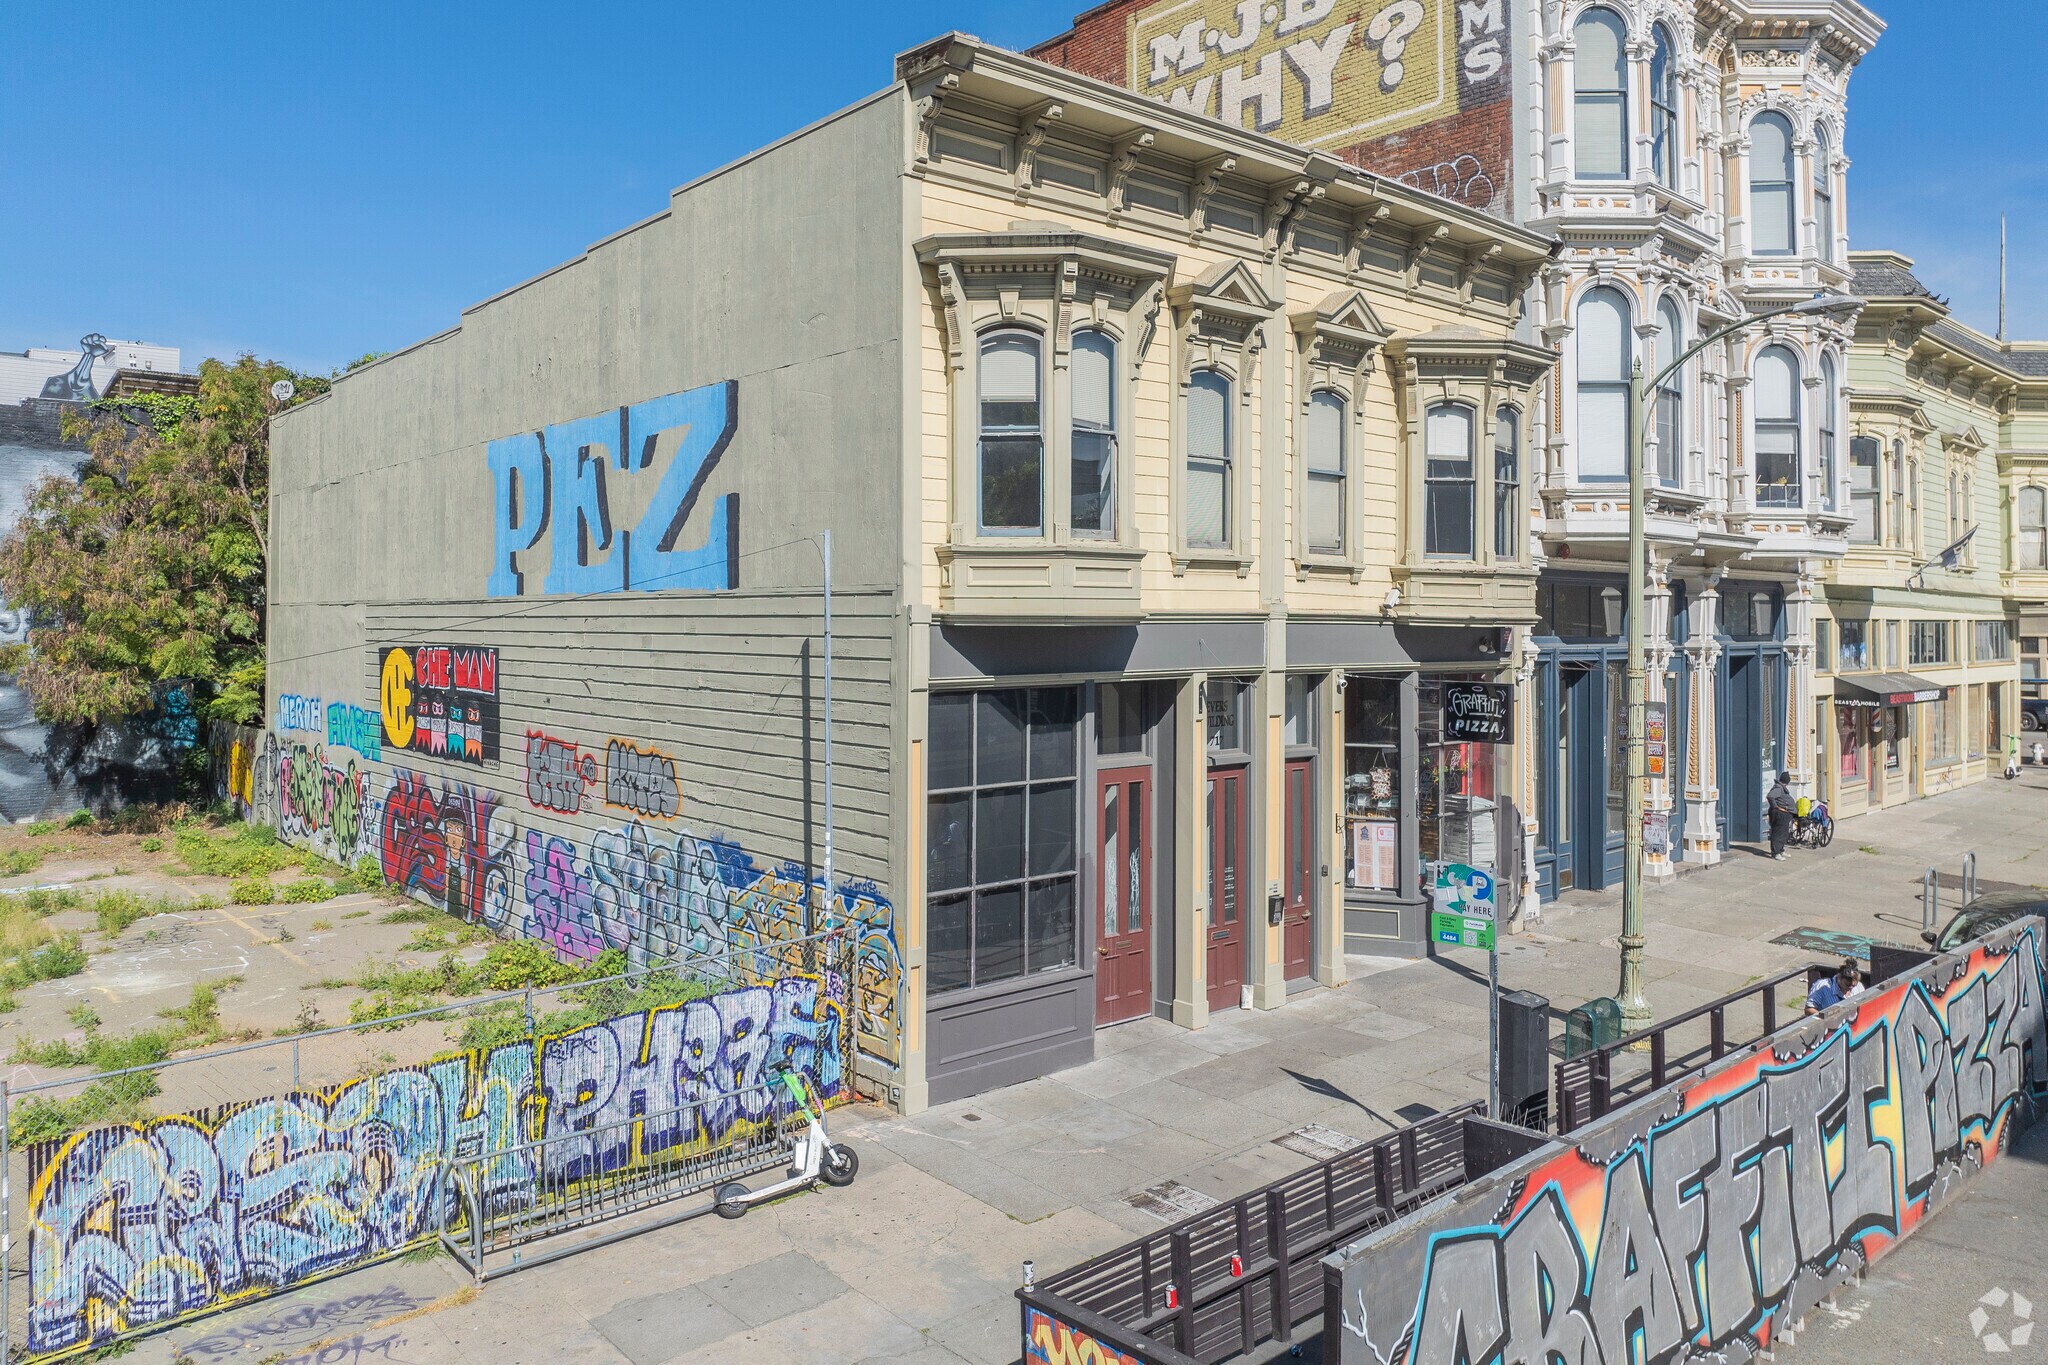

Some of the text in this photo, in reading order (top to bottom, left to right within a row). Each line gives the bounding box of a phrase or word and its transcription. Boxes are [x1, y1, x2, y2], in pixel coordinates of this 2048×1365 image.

[1455, 719, 1500, 734] PIZZA
[1458, 903, 1491, 916] PAY HERE
